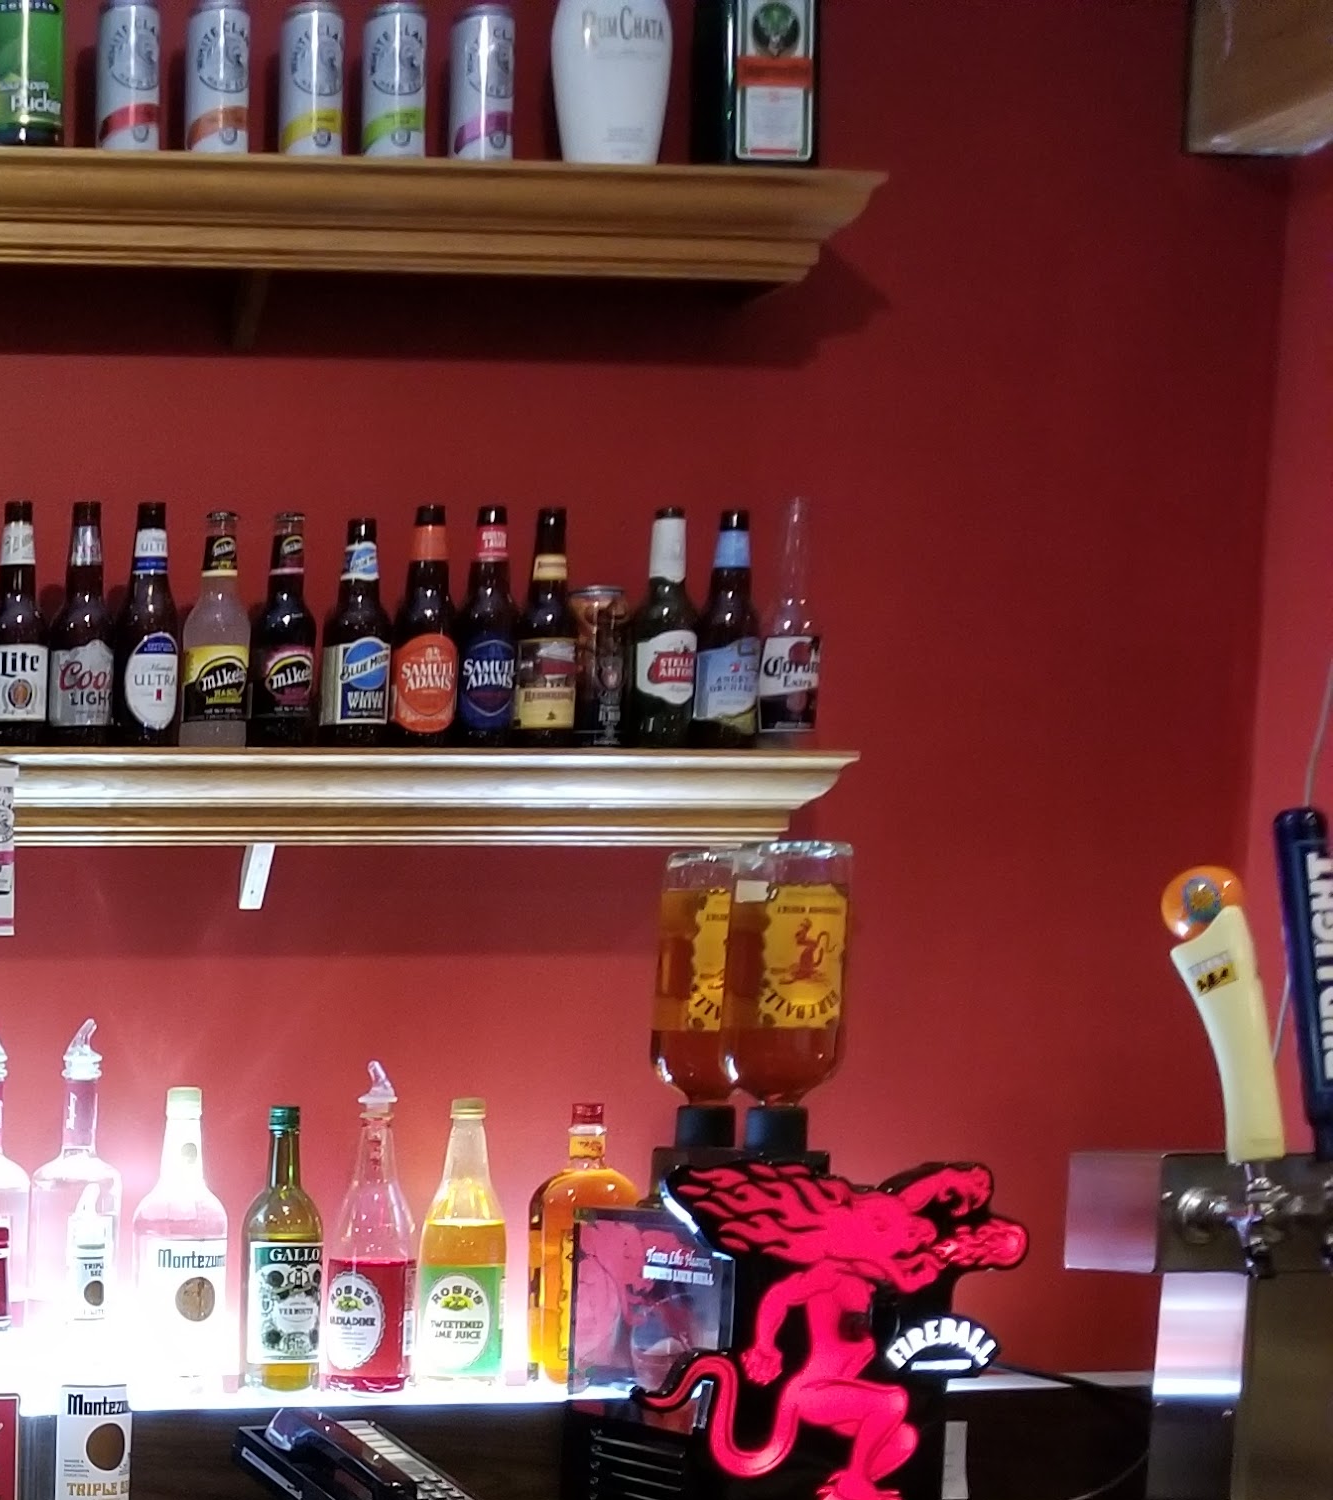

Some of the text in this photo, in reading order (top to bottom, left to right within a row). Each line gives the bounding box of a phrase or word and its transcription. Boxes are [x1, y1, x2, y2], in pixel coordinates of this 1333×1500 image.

[0, 651, 40, 678] Lite
[401, 662, 455, 680] SAMUEL
[462, 658, 516, 677] SAMUEL
[404, 673, 453, 692] ADAMS
[467, 672, 513, 691] ADAMS
[269, 1248, 320, 1262] GALLO
[455, 1330, 481, 1339] JUICE
[886, 1317, 997, 1369] FIREBALL
[67, 1482, 118, 1496] TRIPLE
